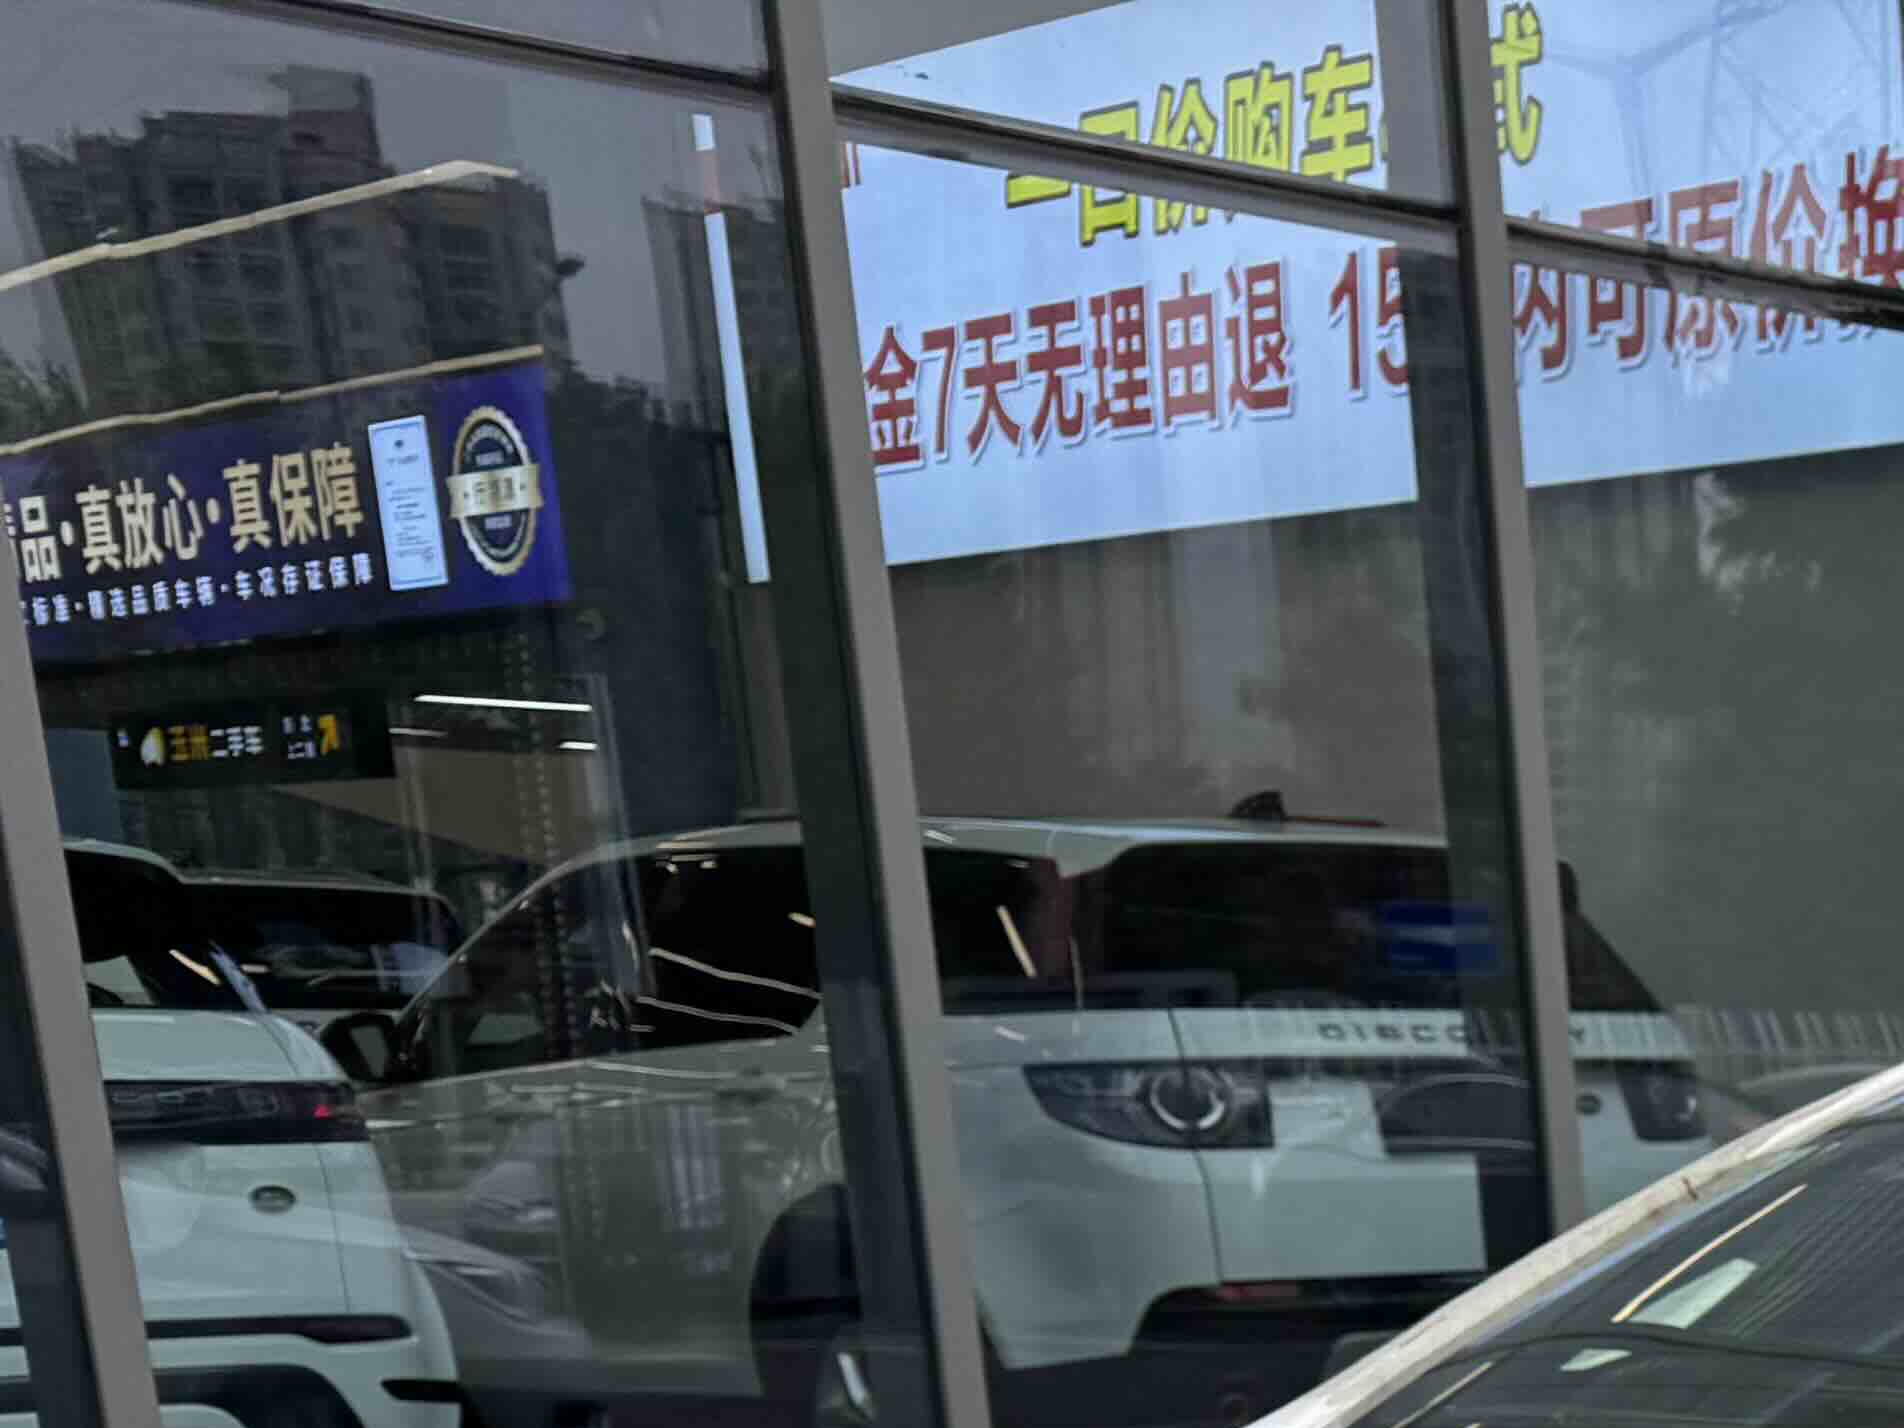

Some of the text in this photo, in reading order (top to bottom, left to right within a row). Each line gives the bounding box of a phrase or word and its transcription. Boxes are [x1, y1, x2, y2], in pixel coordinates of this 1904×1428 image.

[864, 262, 1292, 467] 金7天无理由退
[4, 441, 364, 582] 品·真放心·真保障
